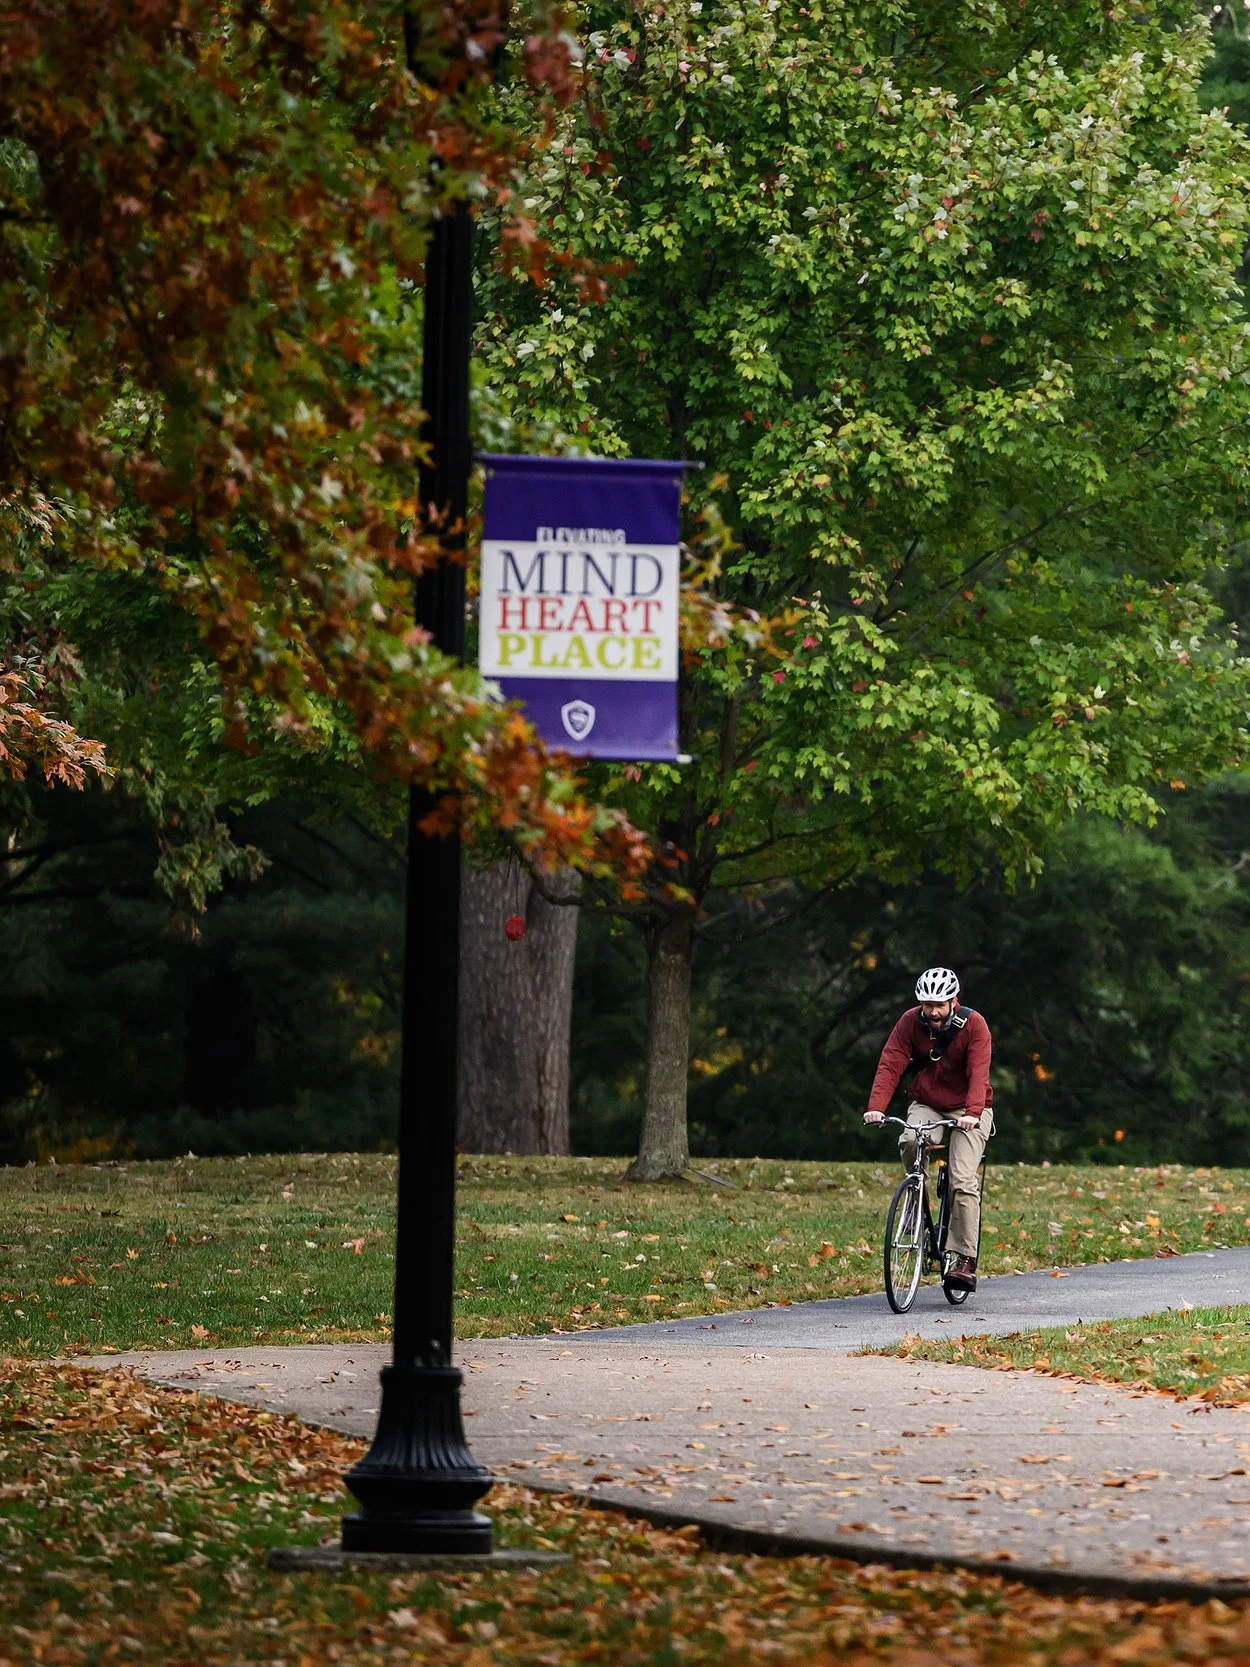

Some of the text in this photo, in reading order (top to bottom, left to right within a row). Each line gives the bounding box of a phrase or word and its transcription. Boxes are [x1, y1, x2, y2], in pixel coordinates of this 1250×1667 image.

[498, 551, 663, 596] MIND
[497, 596, 663, 633] HEART
[497, 634, 661, 670] PLACE
